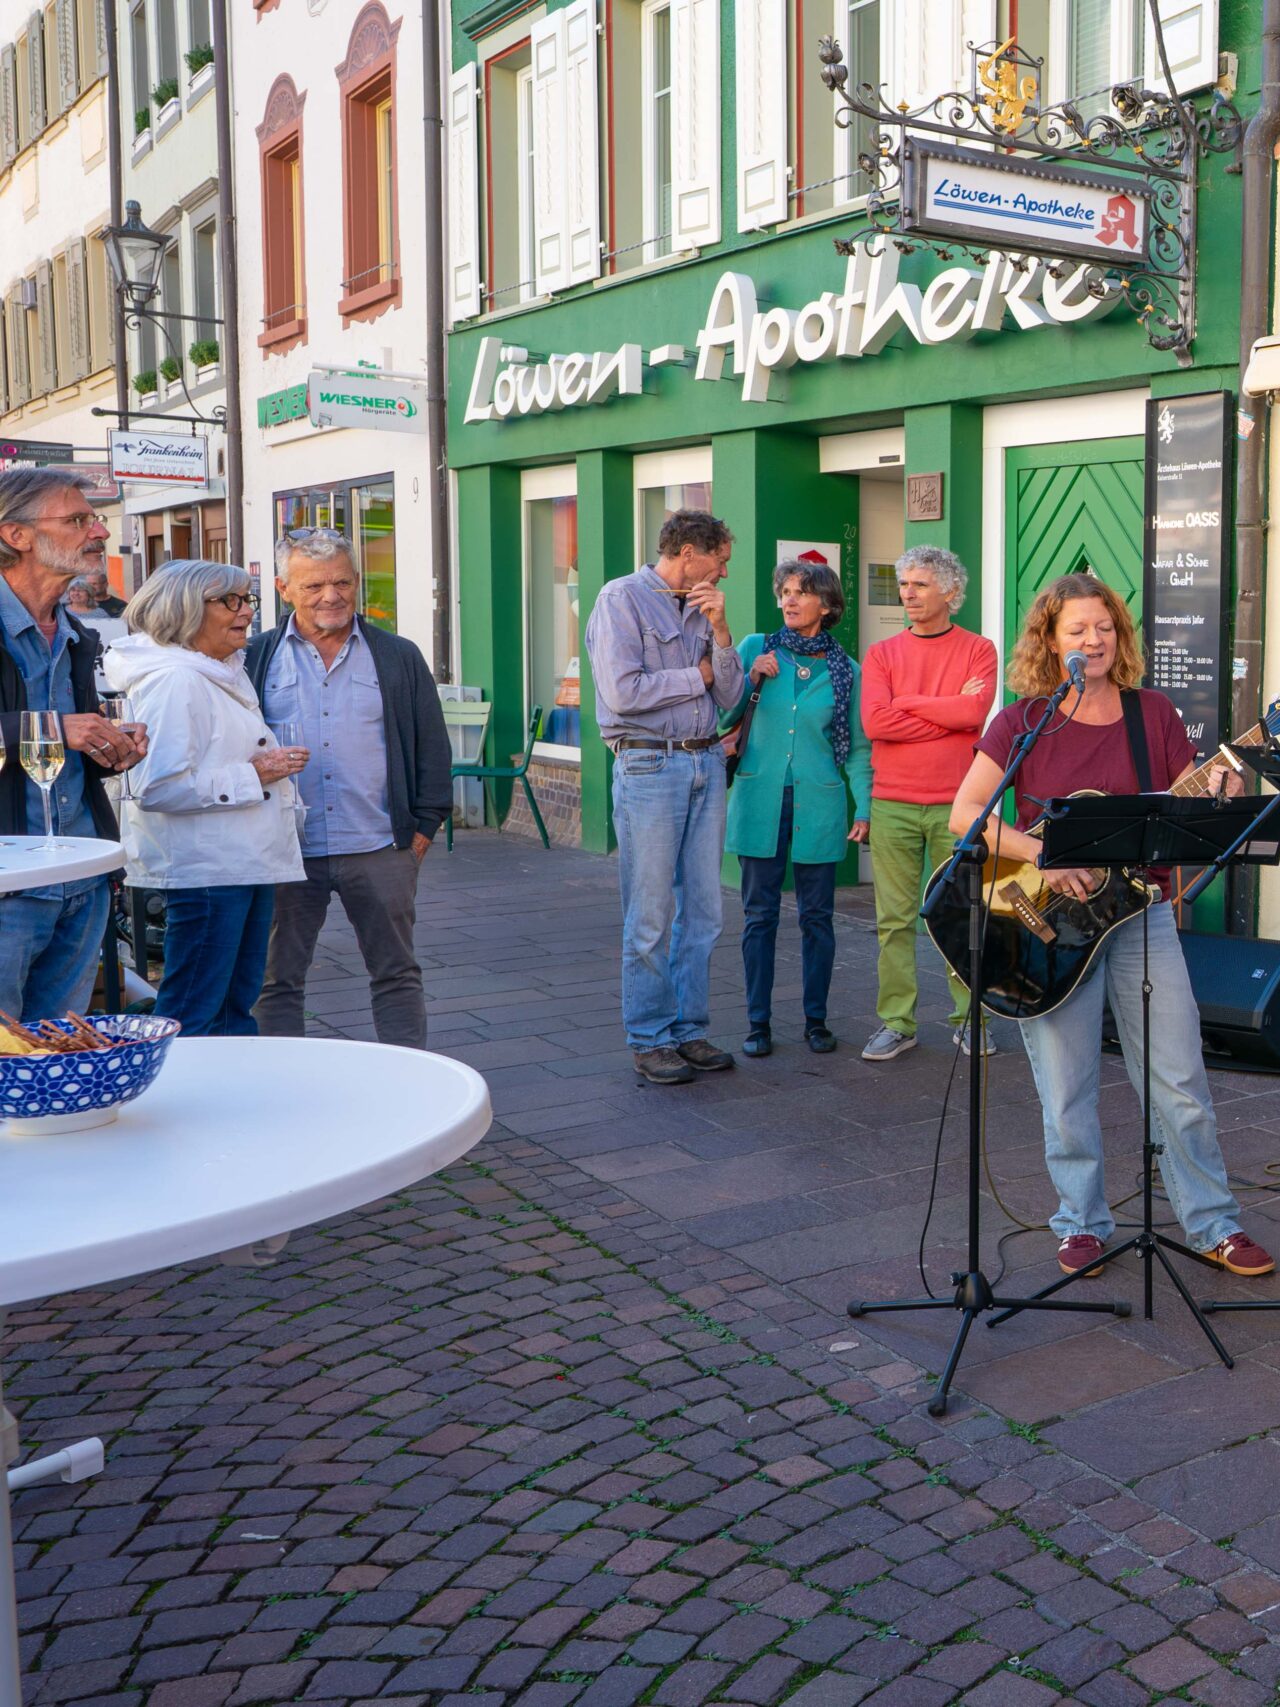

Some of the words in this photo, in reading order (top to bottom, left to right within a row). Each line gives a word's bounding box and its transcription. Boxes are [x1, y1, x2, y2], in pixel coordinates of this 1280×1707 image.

[933, 177, 1095, 222] Löwen-Apotheke
[257, 383, 309, 428] WIESNER
[319, 392, 397, 410] WIESNER
[361, 407, 397, 416] Hörgeräte
[136, 438, 204, 461] Frankenheim
[1182, 460, 1222, 472] Löwen-Apotheke
[1186, 511, 1220, 528] OASIS
[1176, 552, 1184, 568] &
[1154, 615, 1192, 626] Hausarztpraxis
[1192, 615, 1205, 626] Jafar
